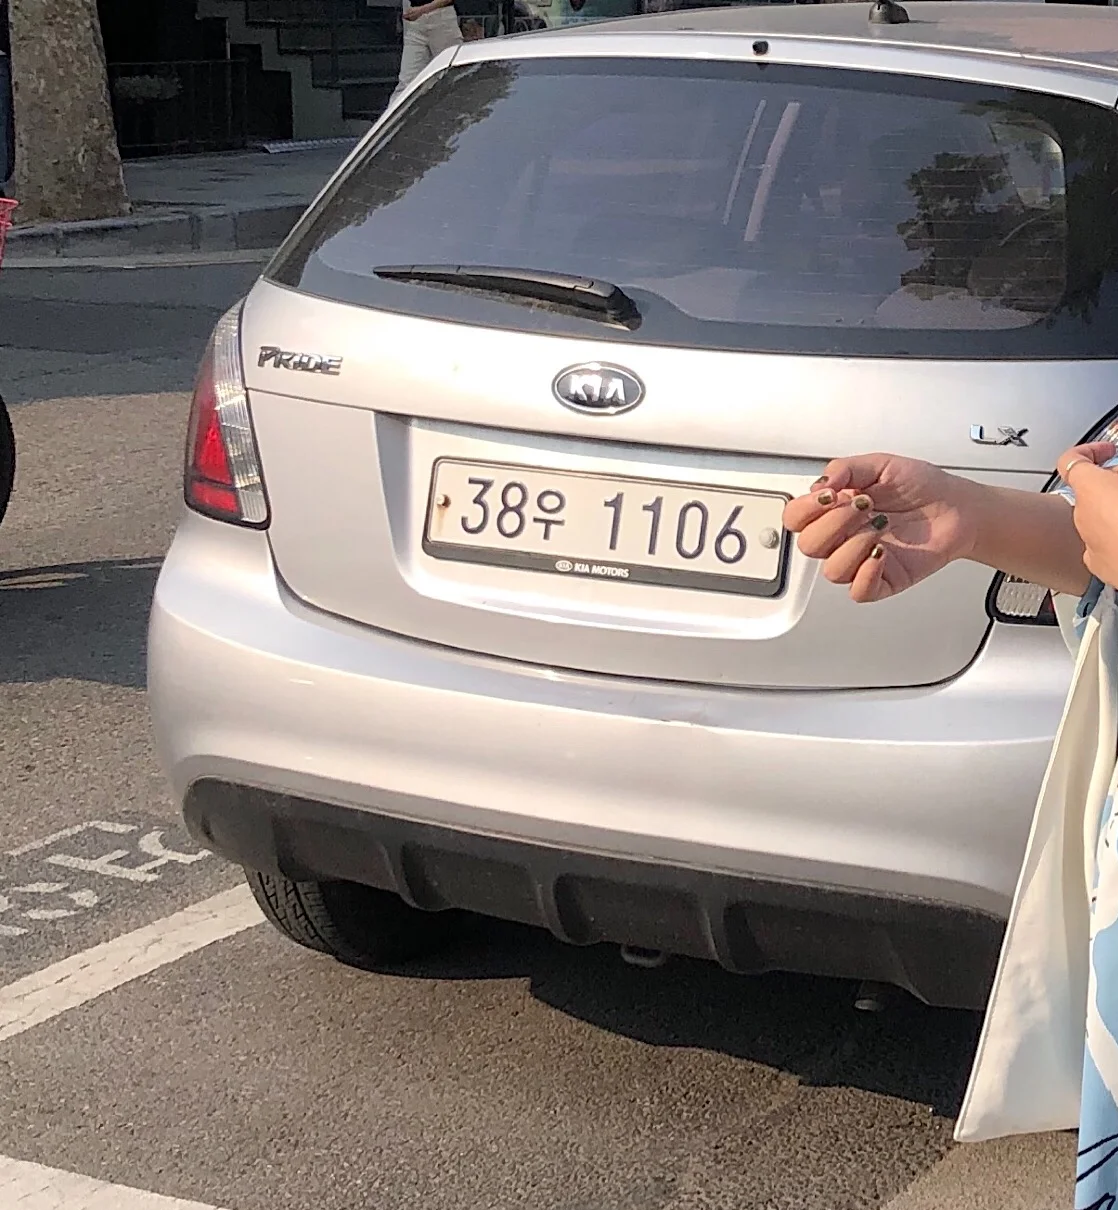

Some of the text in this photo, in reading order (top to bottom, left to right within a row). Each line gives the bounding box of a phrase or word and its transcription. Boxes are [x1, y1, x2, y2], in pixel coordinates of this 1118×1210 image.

[258, 346, 343, 376] PRIDE
[569, 373, 626, 405] KIA
[969, 424, 1029, 447] LX
[461, 477, 748, 565] 38우 1106
[574, 562, 590, 574] KIA
[591, 565, 630, 578] MOTORS
